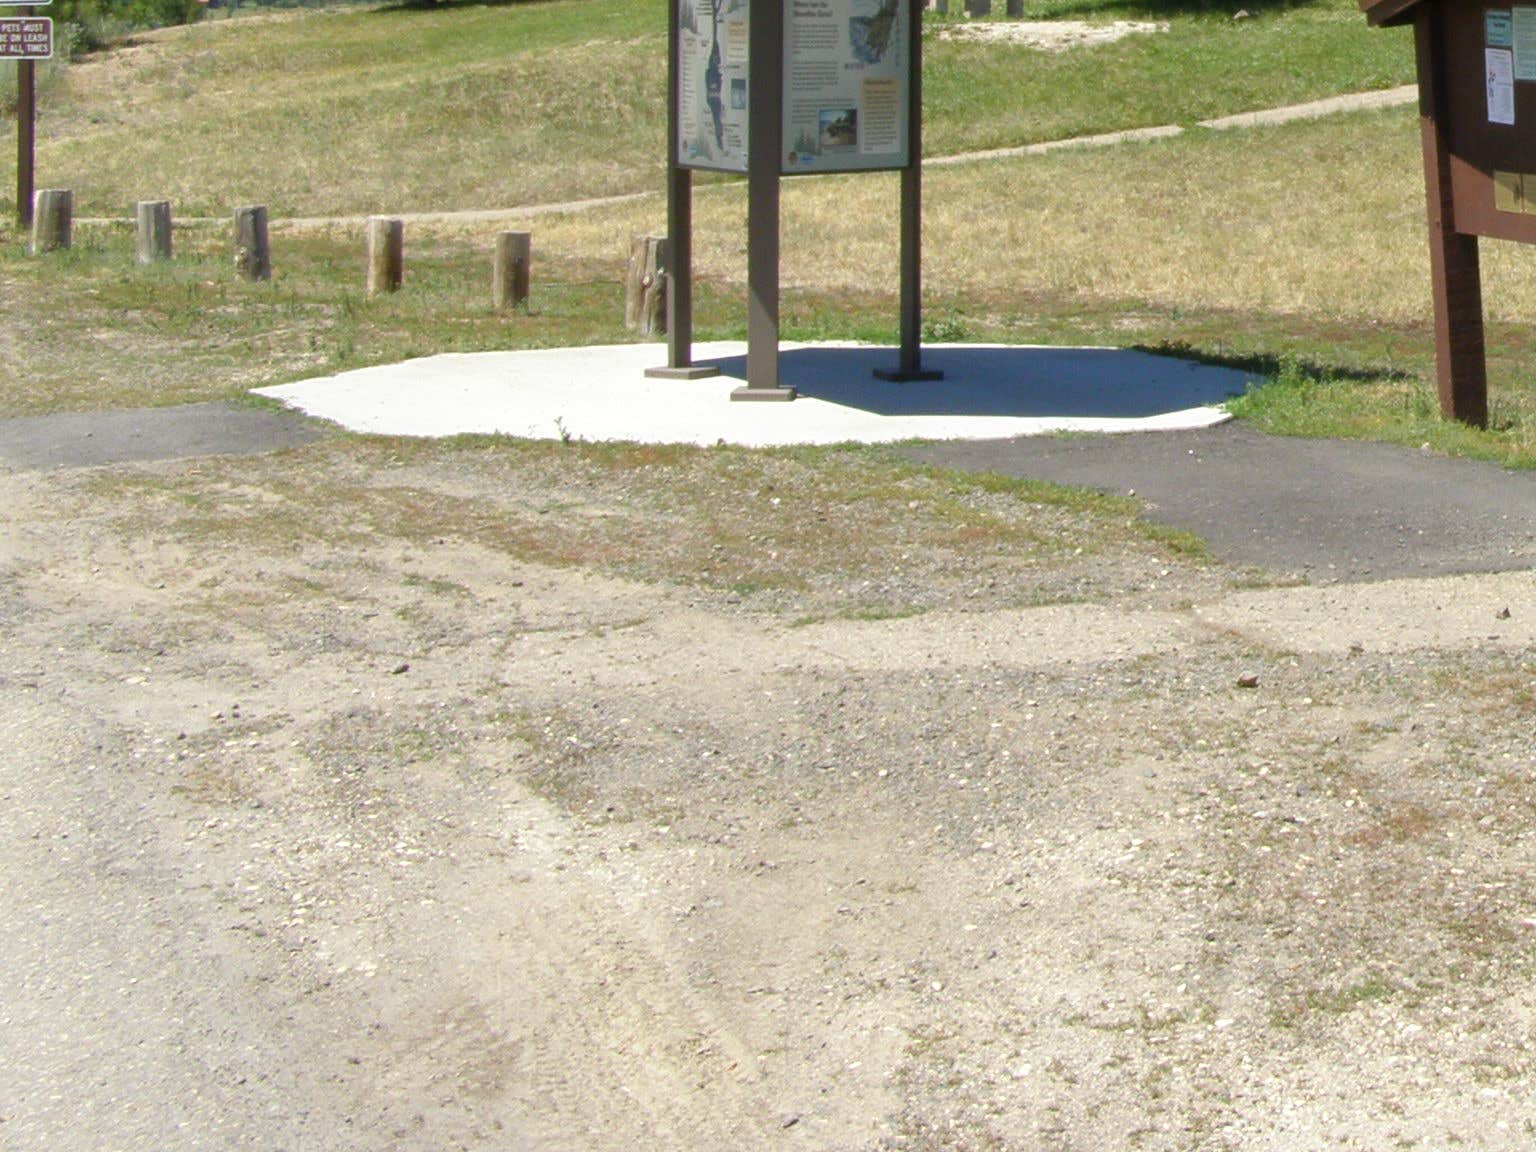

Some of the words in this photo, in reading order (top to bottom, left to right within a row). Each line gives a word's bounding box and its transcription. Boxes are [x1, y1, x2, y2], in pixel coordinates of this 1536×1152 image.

[1, 23, 20, 32] PETS
[23, 23, 44, 32] MUST
[10, 33, 22, 43] ON
[23, 33, 48, 43] LEASH
[10, 43, 22, 53] ALL
[27, 43, 49, 53] TIMES
